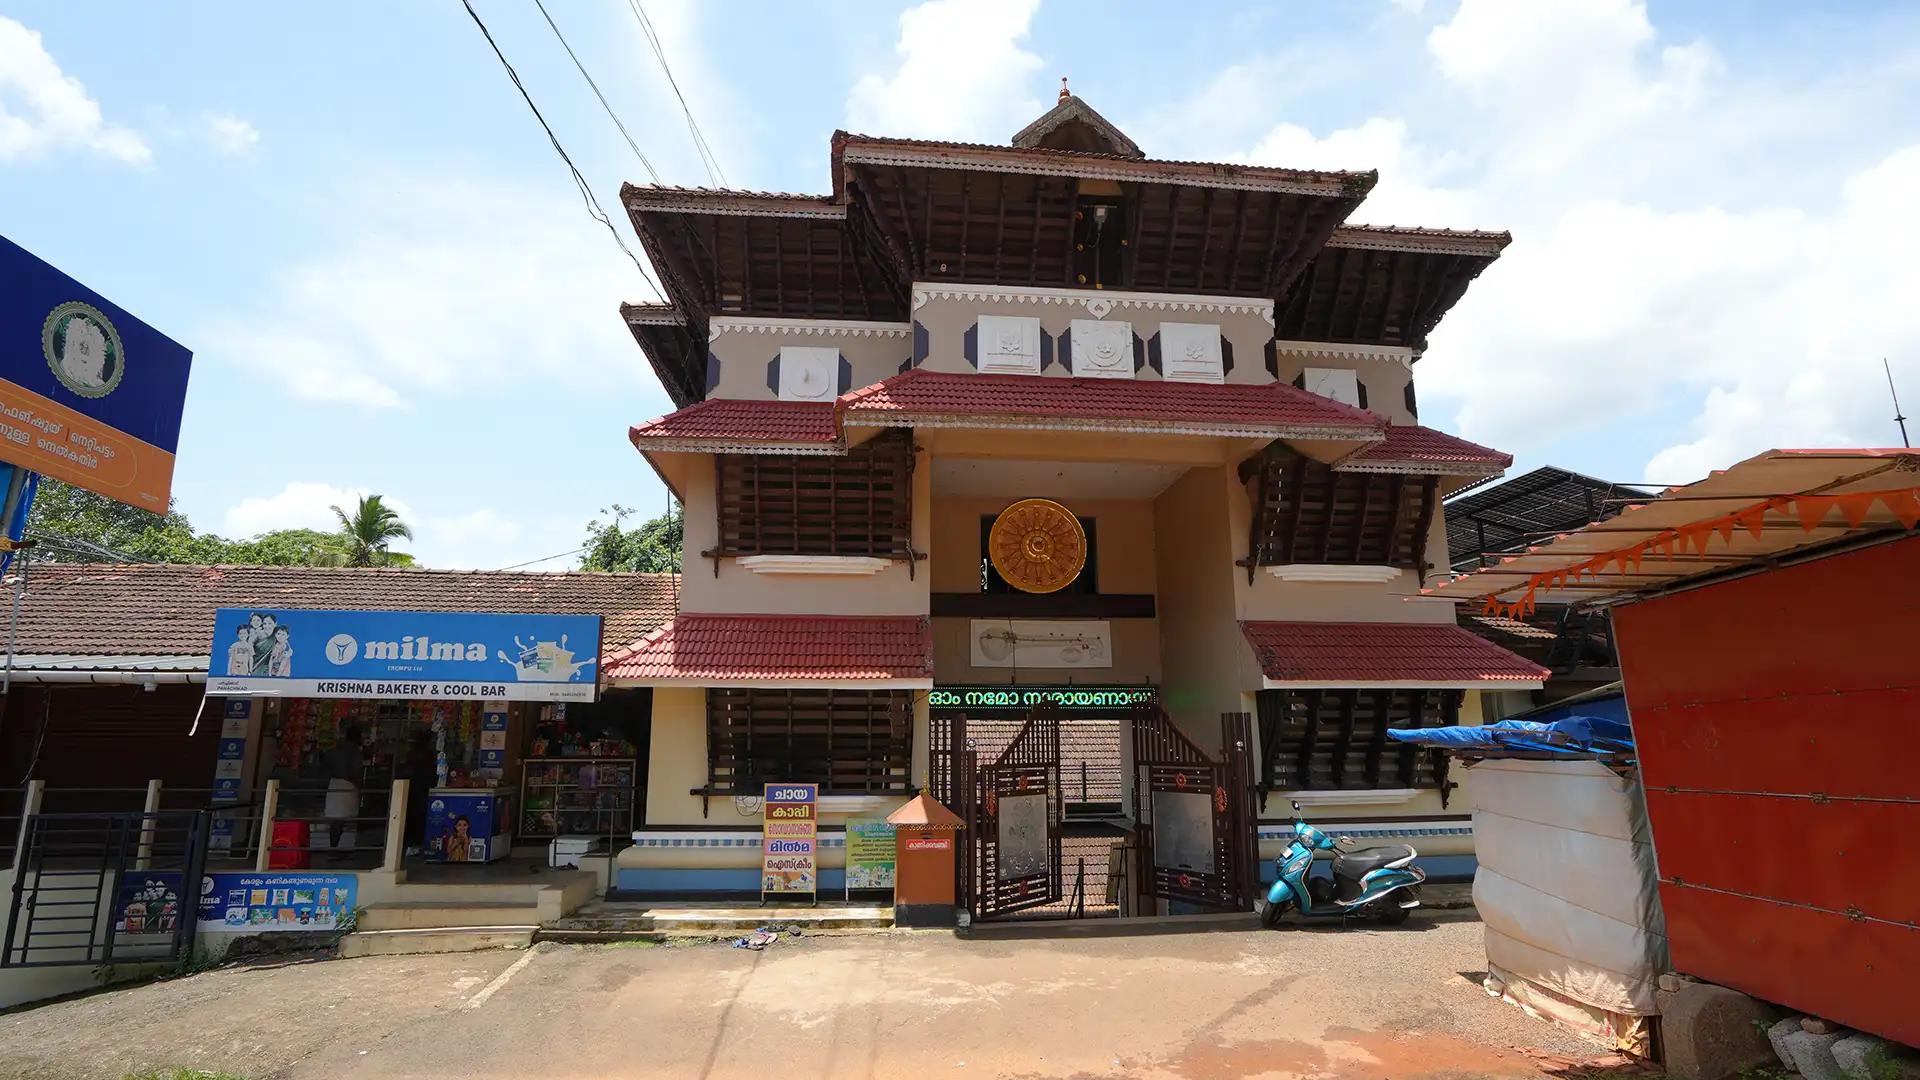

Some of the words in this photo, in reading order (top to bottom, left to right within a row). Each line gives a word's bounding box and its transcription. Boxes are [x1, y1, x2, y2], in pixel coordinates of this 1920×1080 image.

[363, 636, 487, 662] milma
[317, 682, 373, 695] KRISHNA
[376, 683, 427, 695] BAKERY
[431, 683, 440, 695] &
[443, 683, 477, 696] COOL
[481, 684, 506, 696] BAR
[929, 692, 961, 705] ഓം
[965, 692, 1019, 705] നമോ
[774, 789, 808, 801] ചായ
[773, 805, 809, 817] കാപ്പി
[770, 840, 810, 852] മിൽമ
[199, 895, 221, 904] lma
